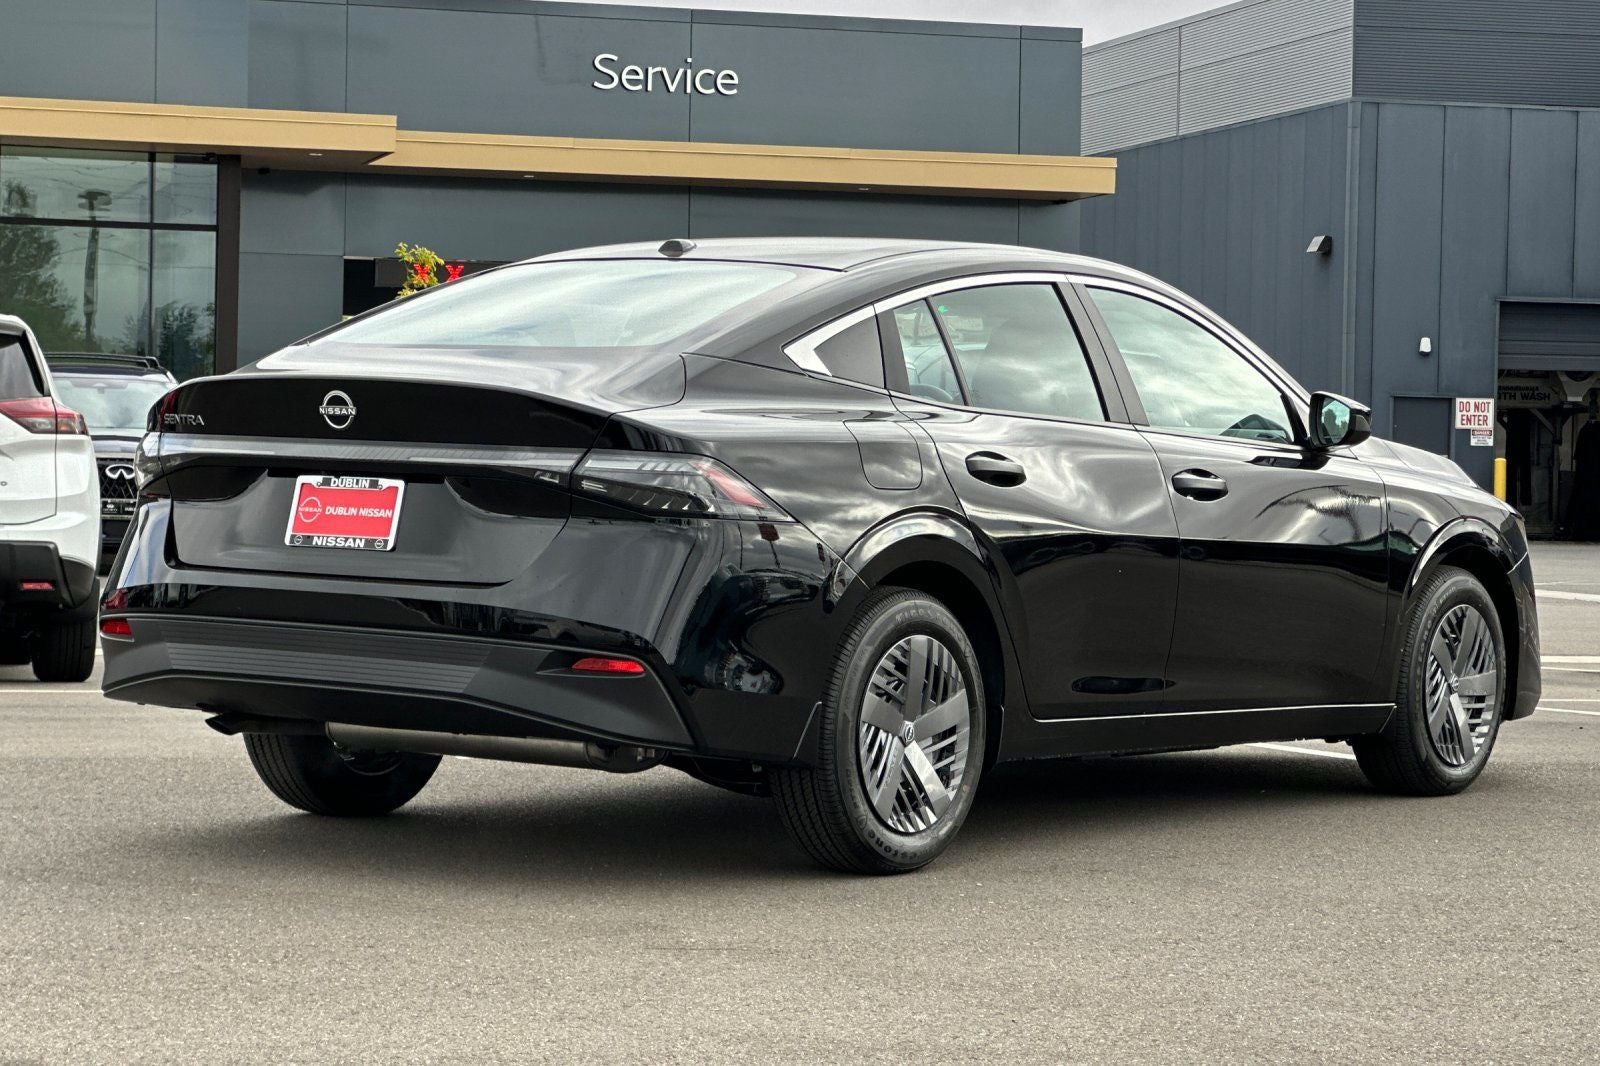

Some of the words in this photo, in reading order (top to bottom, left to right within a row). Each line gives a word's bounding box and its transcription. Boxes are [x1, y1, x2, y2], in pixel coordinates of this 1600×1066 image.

[592, 53, 739, 95] Service
[1521, 392, 1551, 401] WASH
[319, 407, 356, 415] NISSAN
[1459, 401, 1471, 413] DO
[1474, 402, 1491, 413] NOT
[163, 413, 205, 426] SENTRA
[1460, 414, 1489, 426] ENTER
[330, 478, 370, 489] DUBLIN
[325, 506, 356, 516] DUBLIN
[359, 508, 392, 518] NISSAN
[312, 536, 365, 548] NISSAN
